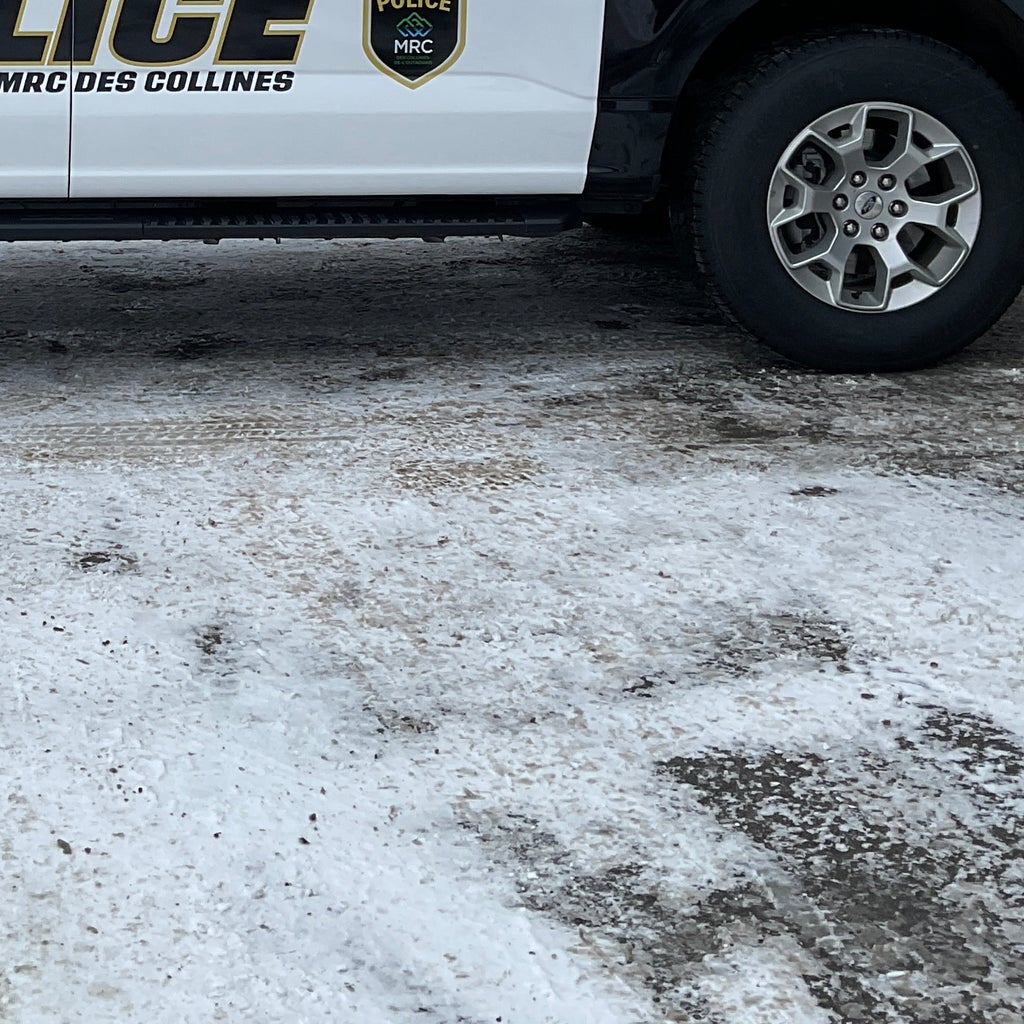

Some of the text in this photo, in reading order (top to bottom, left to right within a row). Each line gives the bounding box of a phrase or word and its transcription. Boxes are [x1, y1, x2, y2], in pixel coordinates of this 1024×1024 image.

[394, 39, 433, 54] MRC
[74, 71, 137, 92] DES
[143, 71, 295, 92] COLLINES
